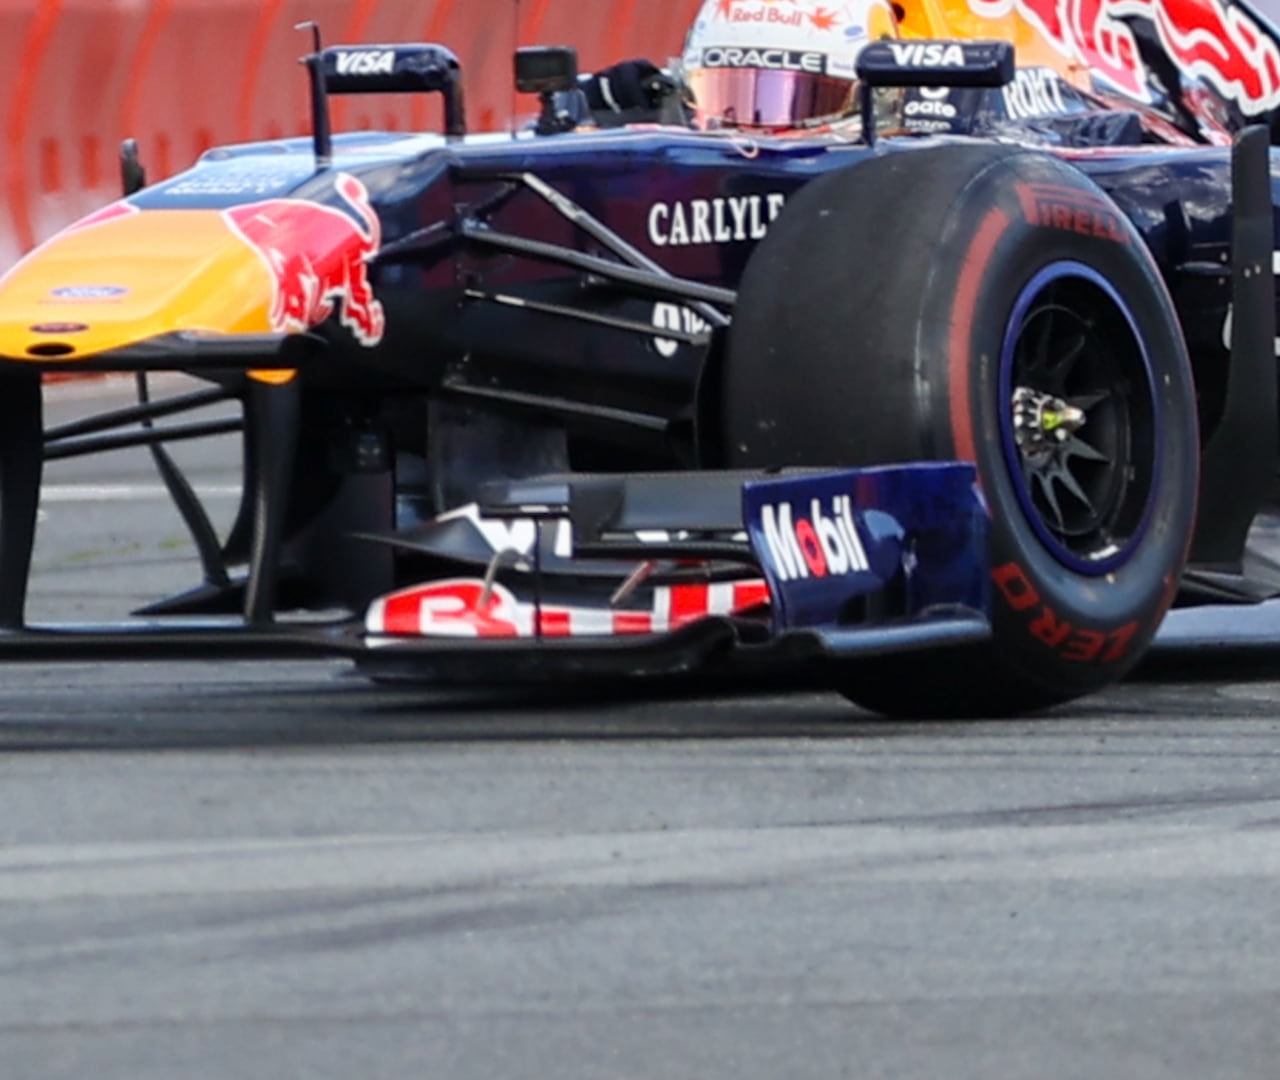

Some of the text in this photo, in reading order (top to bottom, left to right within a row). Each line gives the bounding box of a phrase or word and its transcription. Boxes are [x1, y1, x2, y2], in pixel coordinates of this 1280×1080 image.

[732, 6, 802, 26] Red Bull
[336, 51, 396, 75] VISA
[704, 47, 822, 72] ORACLE
[888, 43, 965, 67] VISA
[761, 494, 869, 581] Mobil
